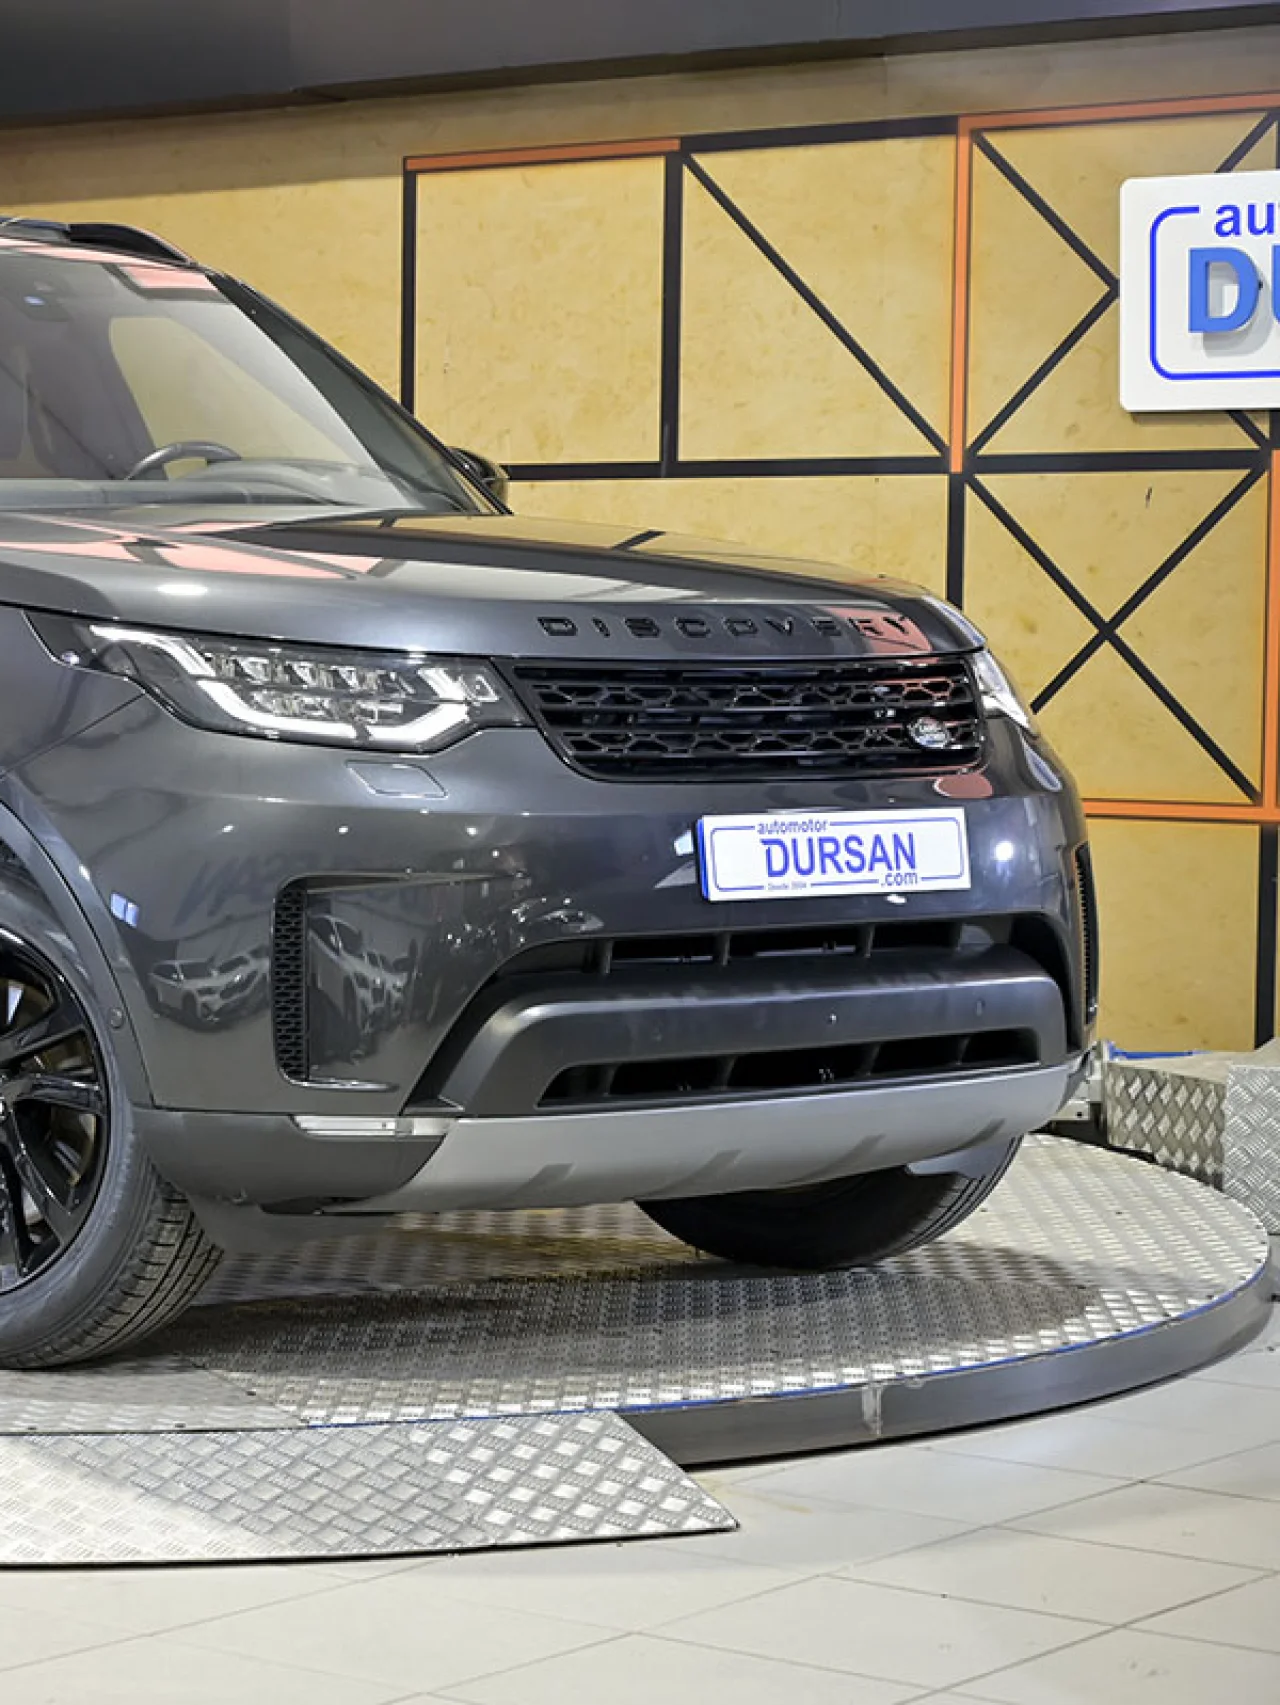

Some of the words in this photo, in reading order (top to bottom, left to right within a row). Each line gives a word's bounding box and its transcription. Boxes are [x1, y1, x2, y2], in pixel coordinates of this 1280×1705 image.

[1214, 202, 1280, 237] au
[1188, 243, 1280, 334] D
[537, 615, 909, 638] DISCOVERY
[758, 819, 828, 835] automotor
[760, 832, 916, 878] DURSAN
[882, 873, 918, 887] .com
